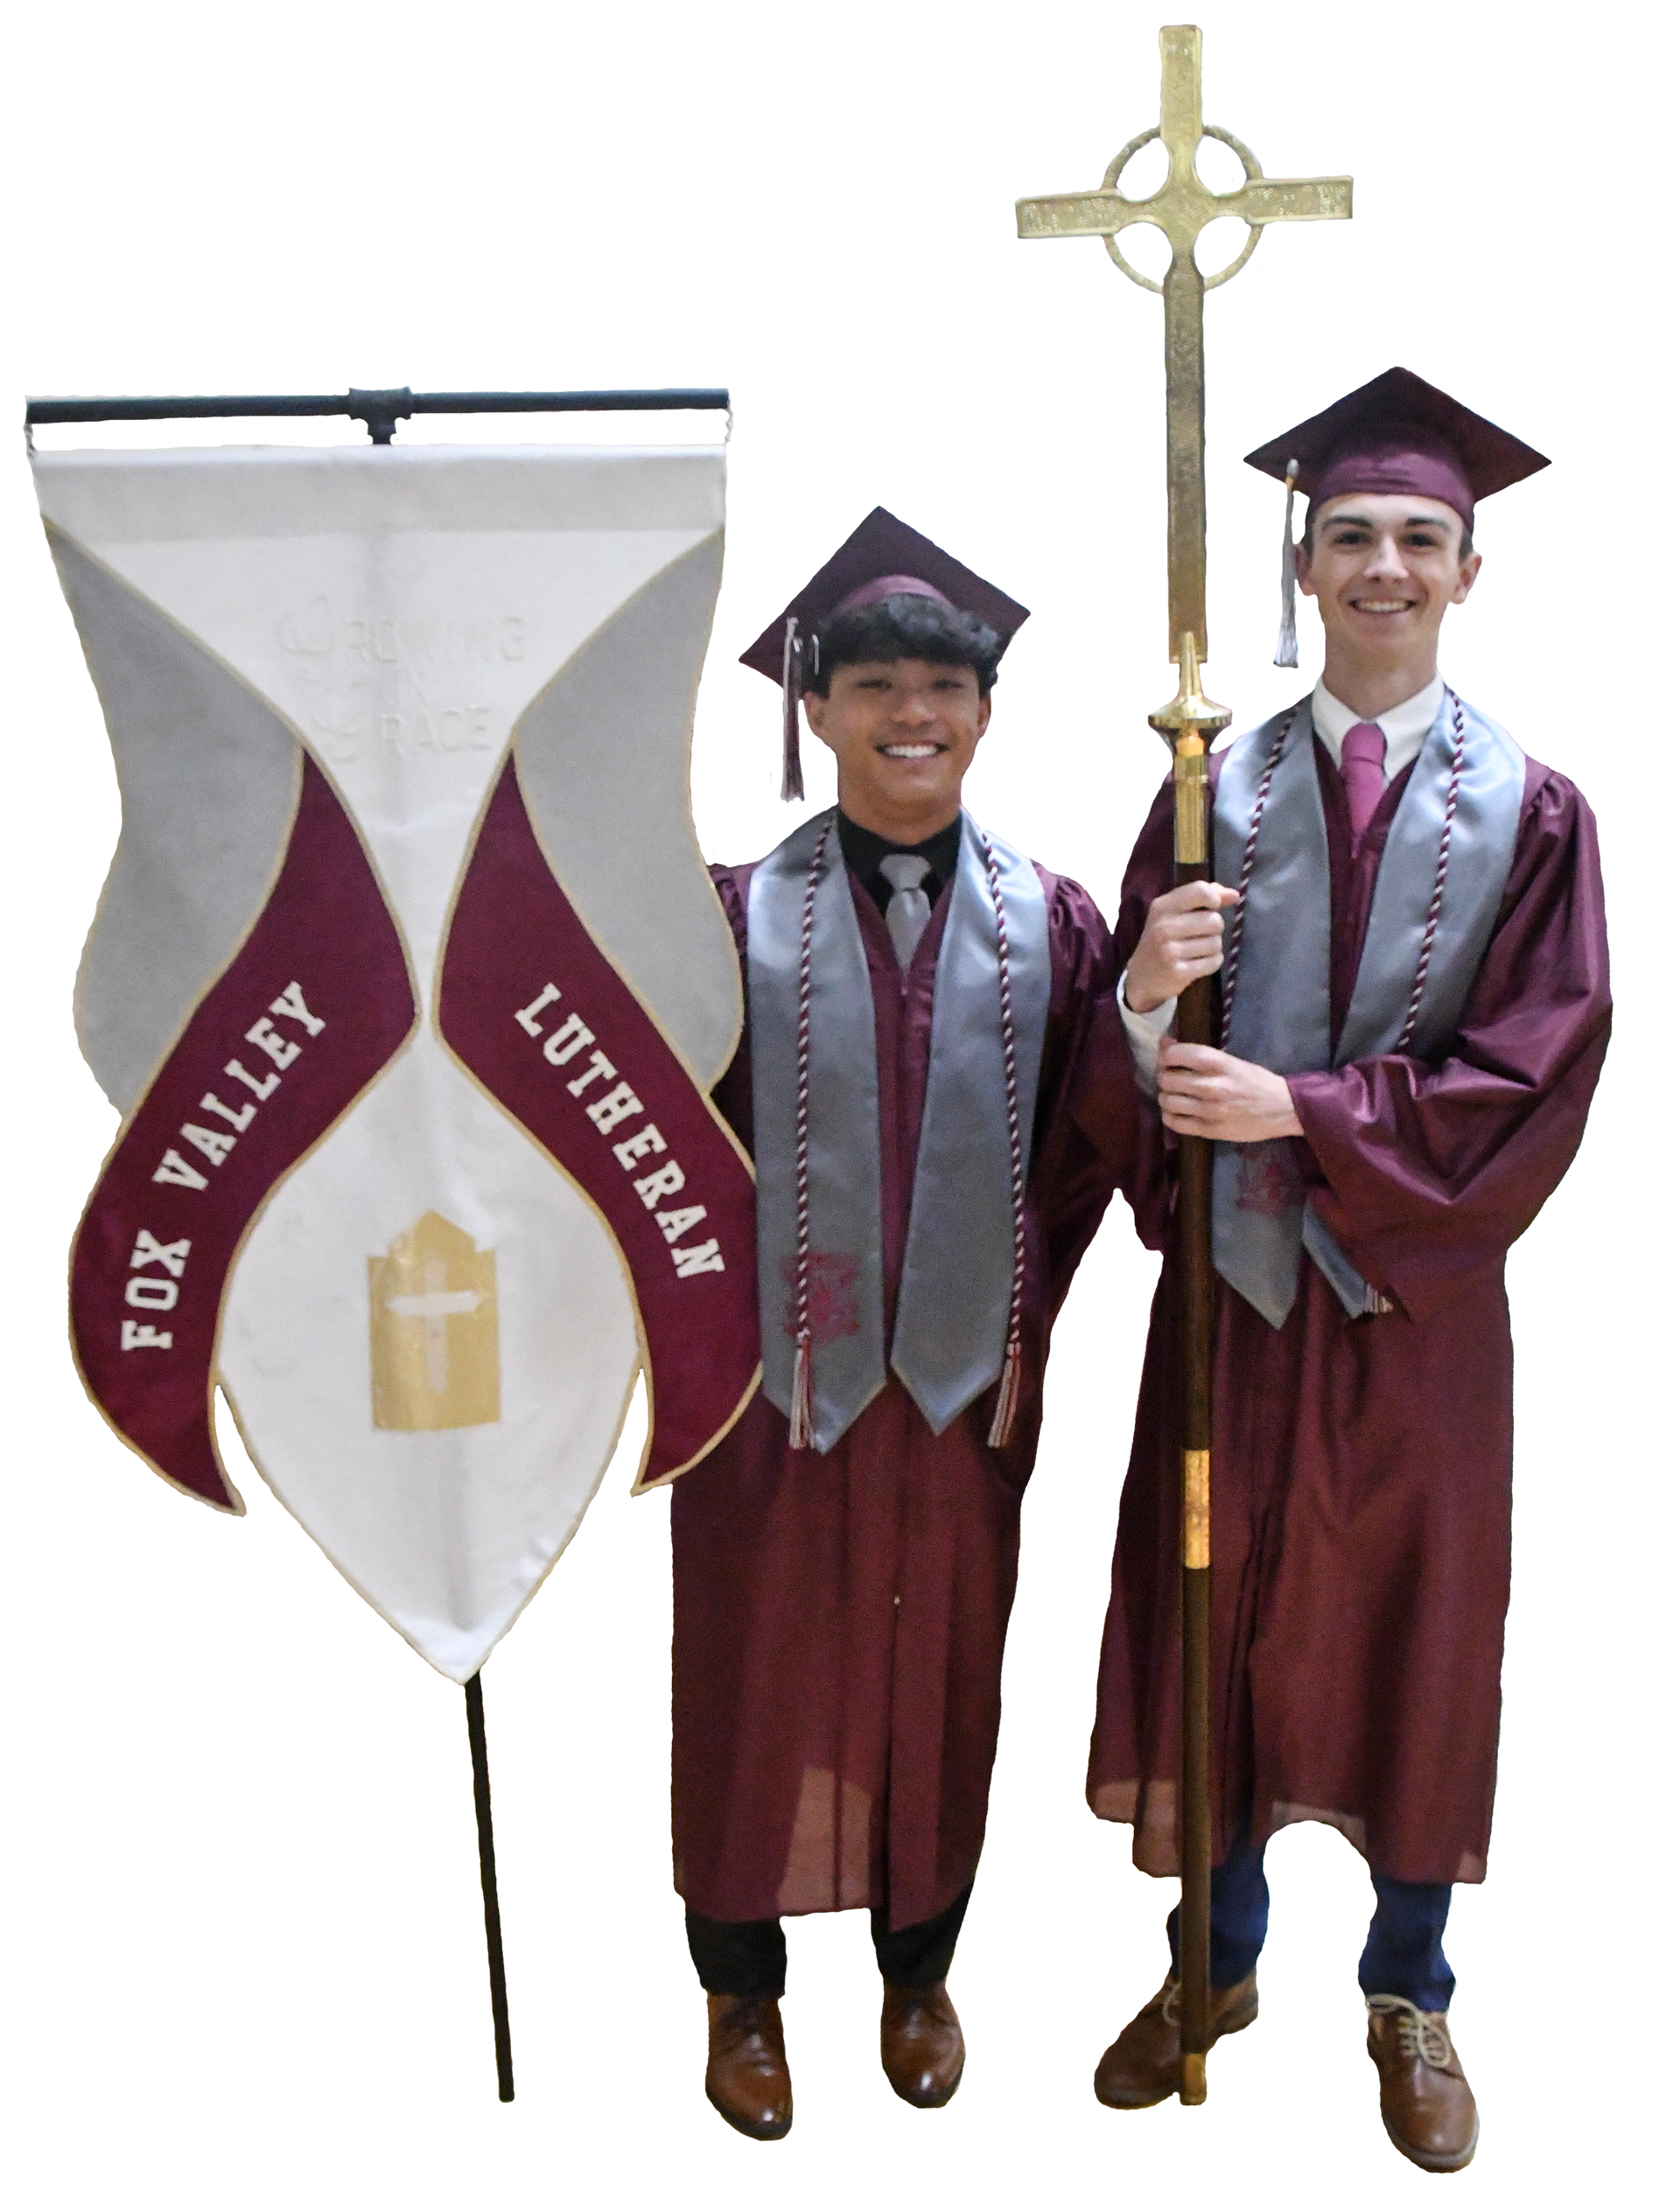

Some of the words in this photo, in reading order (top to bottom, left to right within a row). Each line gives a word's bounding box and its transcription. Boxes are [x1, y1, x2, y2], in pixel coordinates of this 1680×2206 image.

[151, 981, 326, 1191] VALLEY
[514, 982, 725, 1278] LUTHERAN
[121, 1229, 192, 1351] FOX
